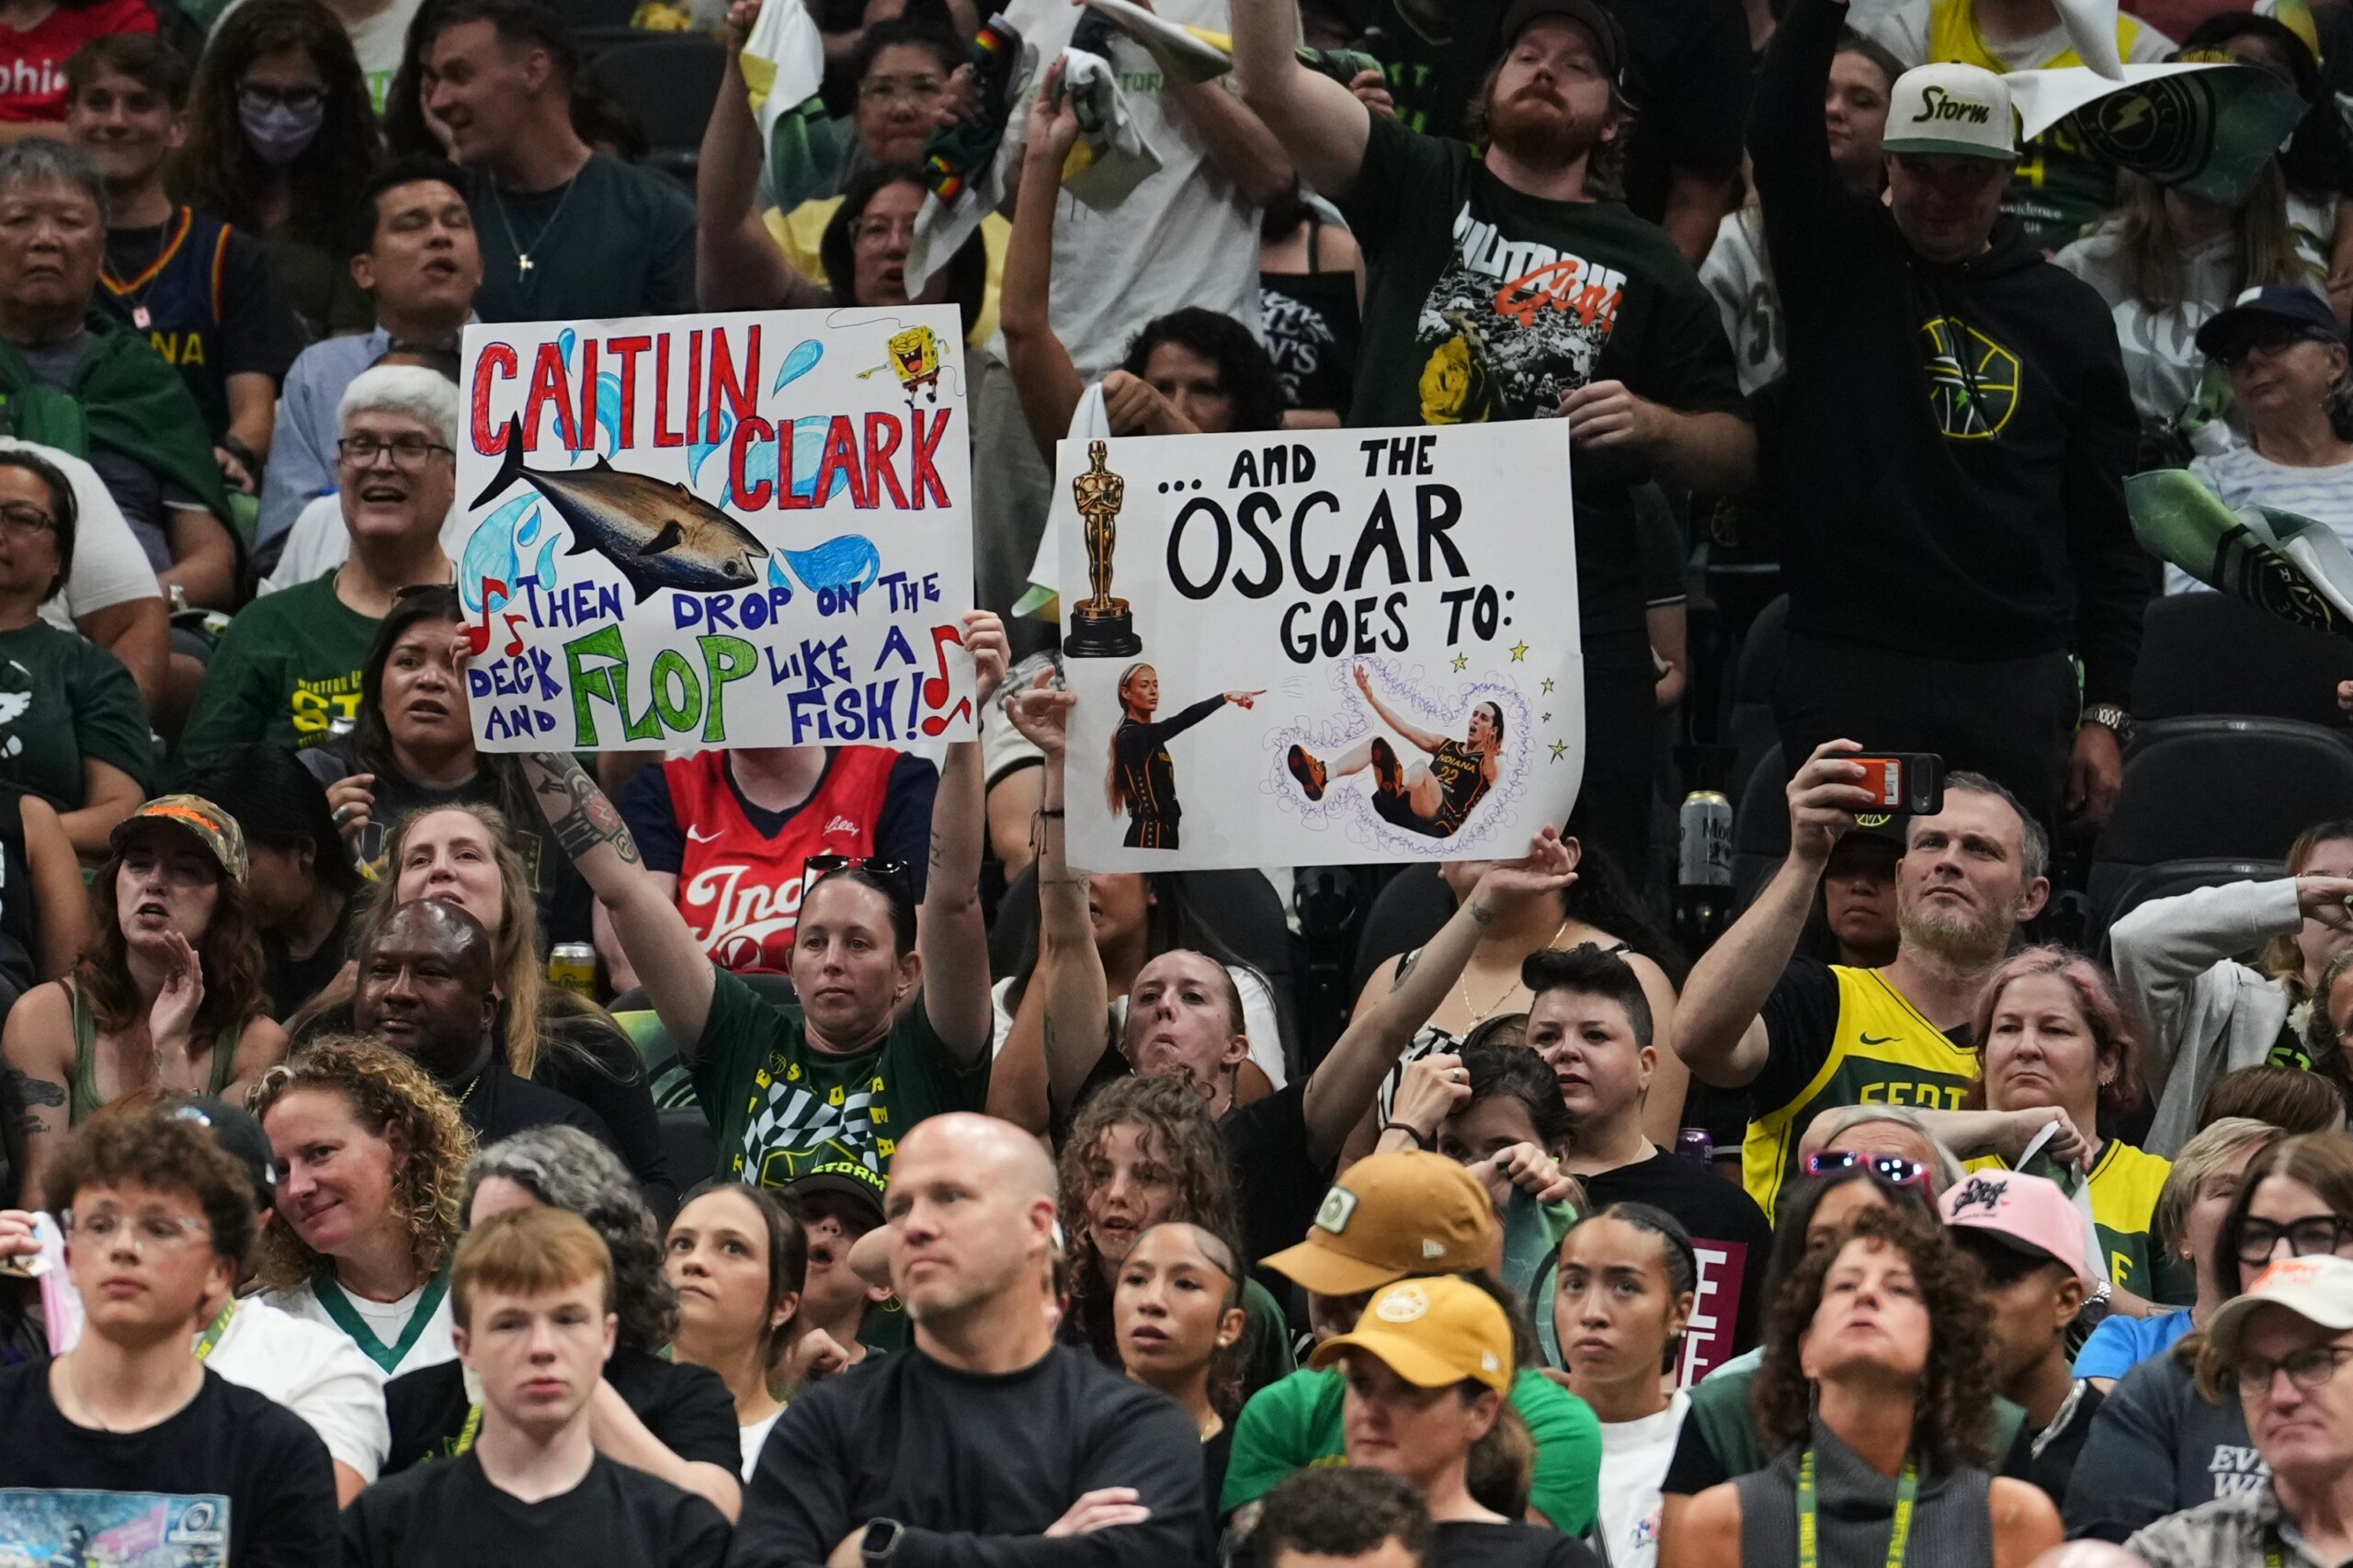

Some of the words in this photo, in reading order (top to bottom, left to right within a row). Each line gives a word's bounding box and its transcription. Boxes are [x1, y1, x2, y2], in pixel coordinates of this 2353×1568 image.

[1912, 85, 1990, 124] Storm
[471, 324, 761, 456] CAITLIN
[730, 407, 951, 511] CLARK
[1359, 435, 1438, 477] THE
[1166, 483, 1470, 600] OSCAR
[516, 574, 625, 629] THEN
[672, 586, 792, 635] DROP
[817, 581, 861, 617] ON
[878, 571, 941, 614] THE
[1280, 591, 1410, 665] GOES
[1440, 584, 1515, 646] TO:
[468, 645, 563, 701] DECK
[563, 623, 758, 747] FLOP
[764, 635, 853, 689] LIKE
[874, 625, 917, 672] A
[484, 705, 557, 741] AND
[787, 672, 925, 745] FISH!
[811, 1161, 887, 1192] STORM
